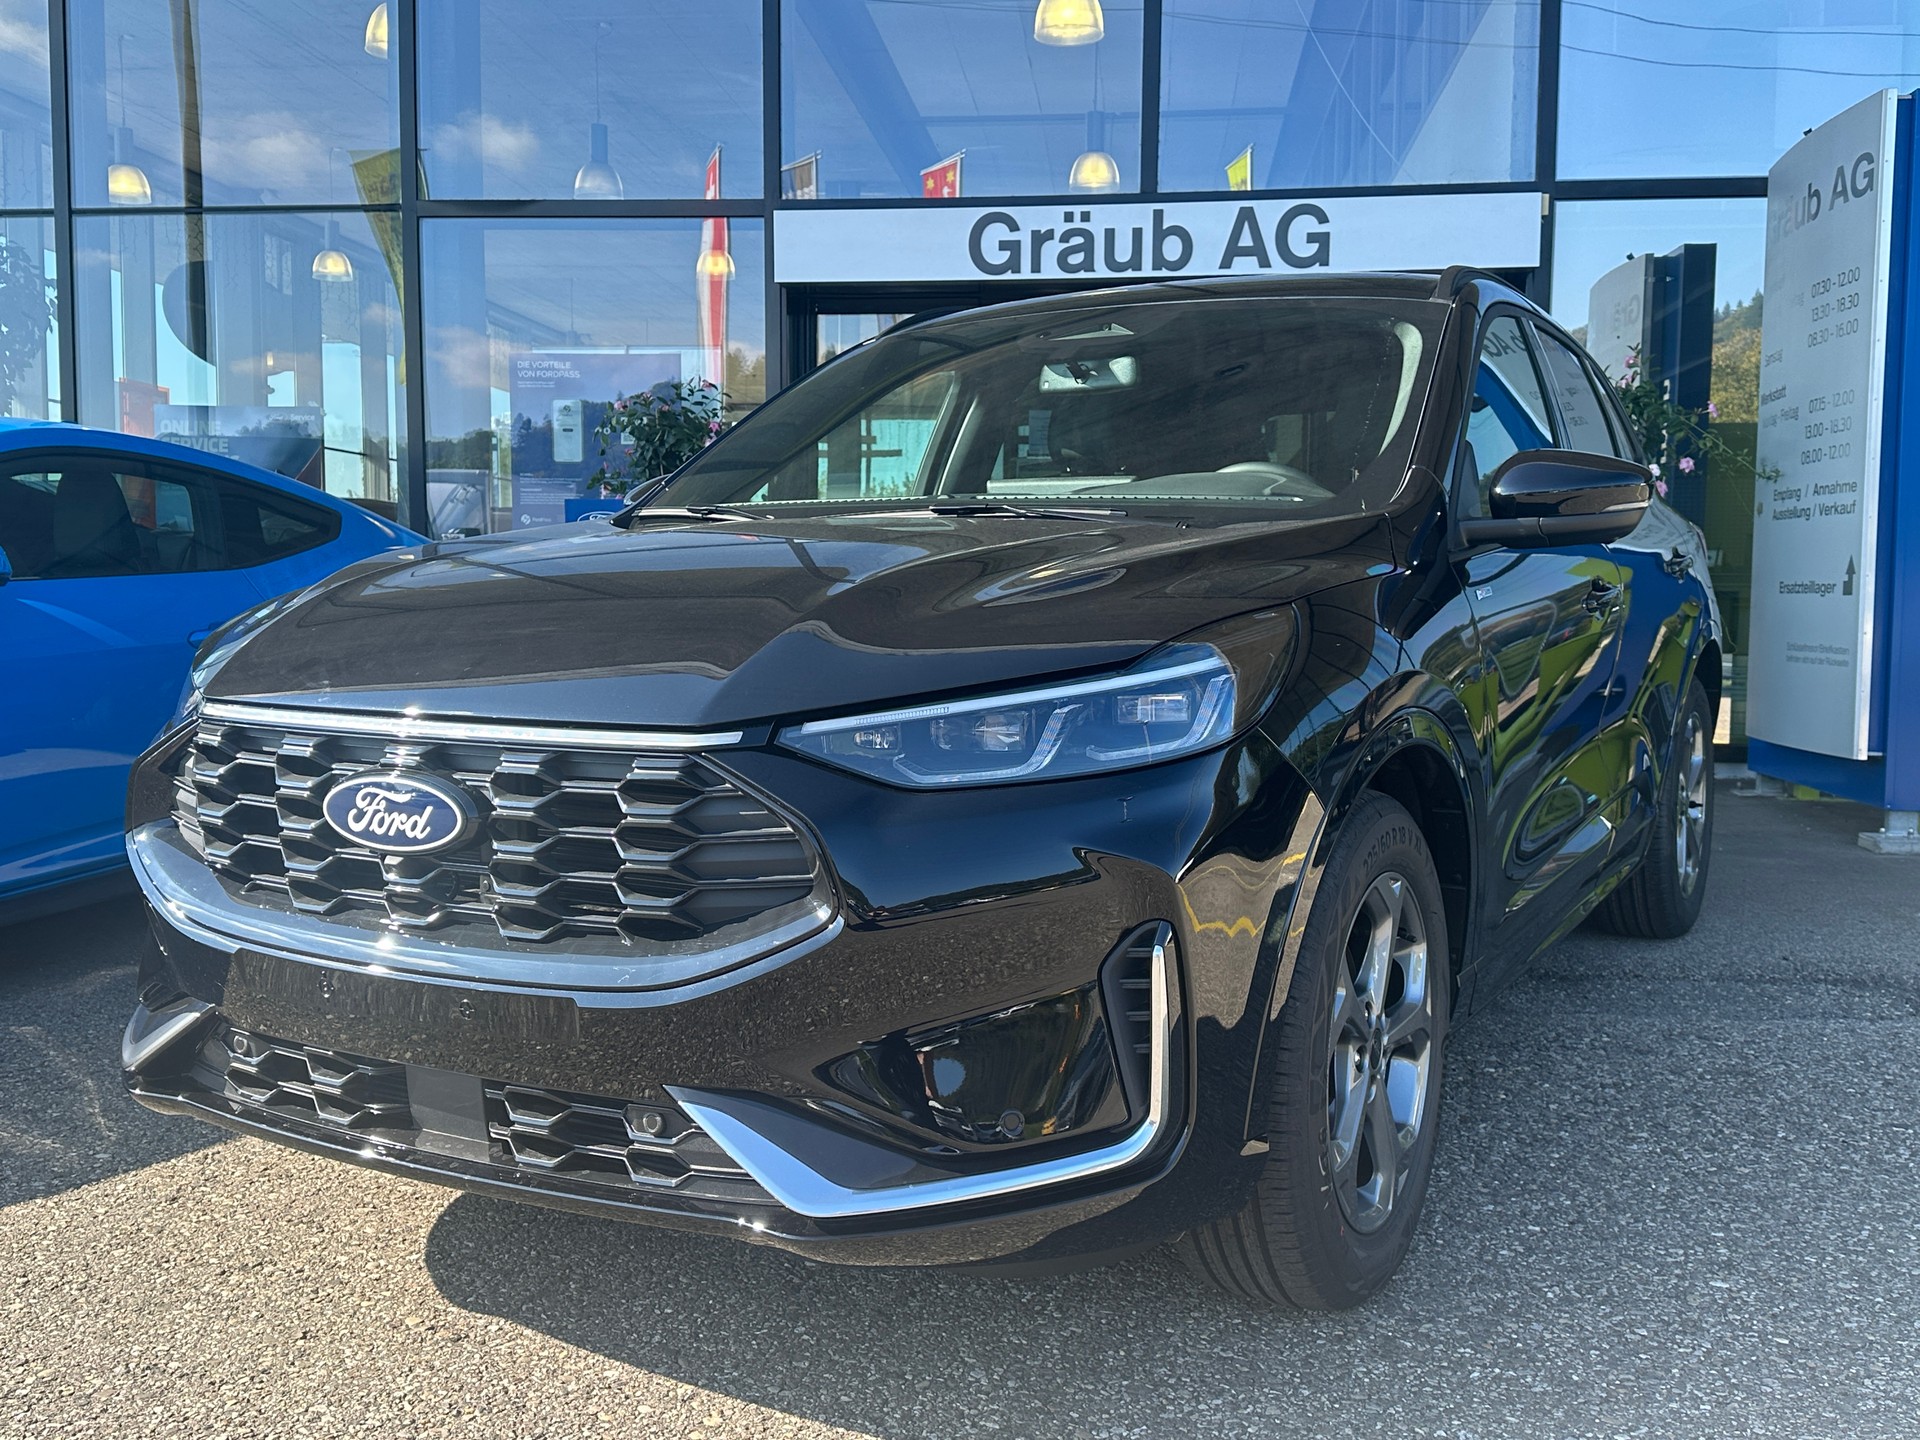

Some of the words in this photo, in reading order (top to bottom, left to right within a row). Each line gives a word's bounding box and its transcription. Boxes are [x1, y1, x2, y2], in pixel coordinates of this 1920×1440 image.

[1828, 152, 1874, 211] AG
[968, 208, 1194, 276] Gräub
[1218, 203, 1331, 270] AG
[1838, 266, 1860, 288] 12.00
[1837, 292, 1860, 312] 18.30
[1836, 318, 1858, 338] 16.00
[160, 420, 222, 436] ONLINE
[1774, 487, 1801, 502] Empfang
[1812, 480, 1858, 496] Annahme
[1772, 506, 1810, 520] Ausstellung
[1818, 500, 1856, 516] Verkauf
[1779, 581, 1837, 597] Ersatzteillager
[348, 786, 434, 840] Ford
